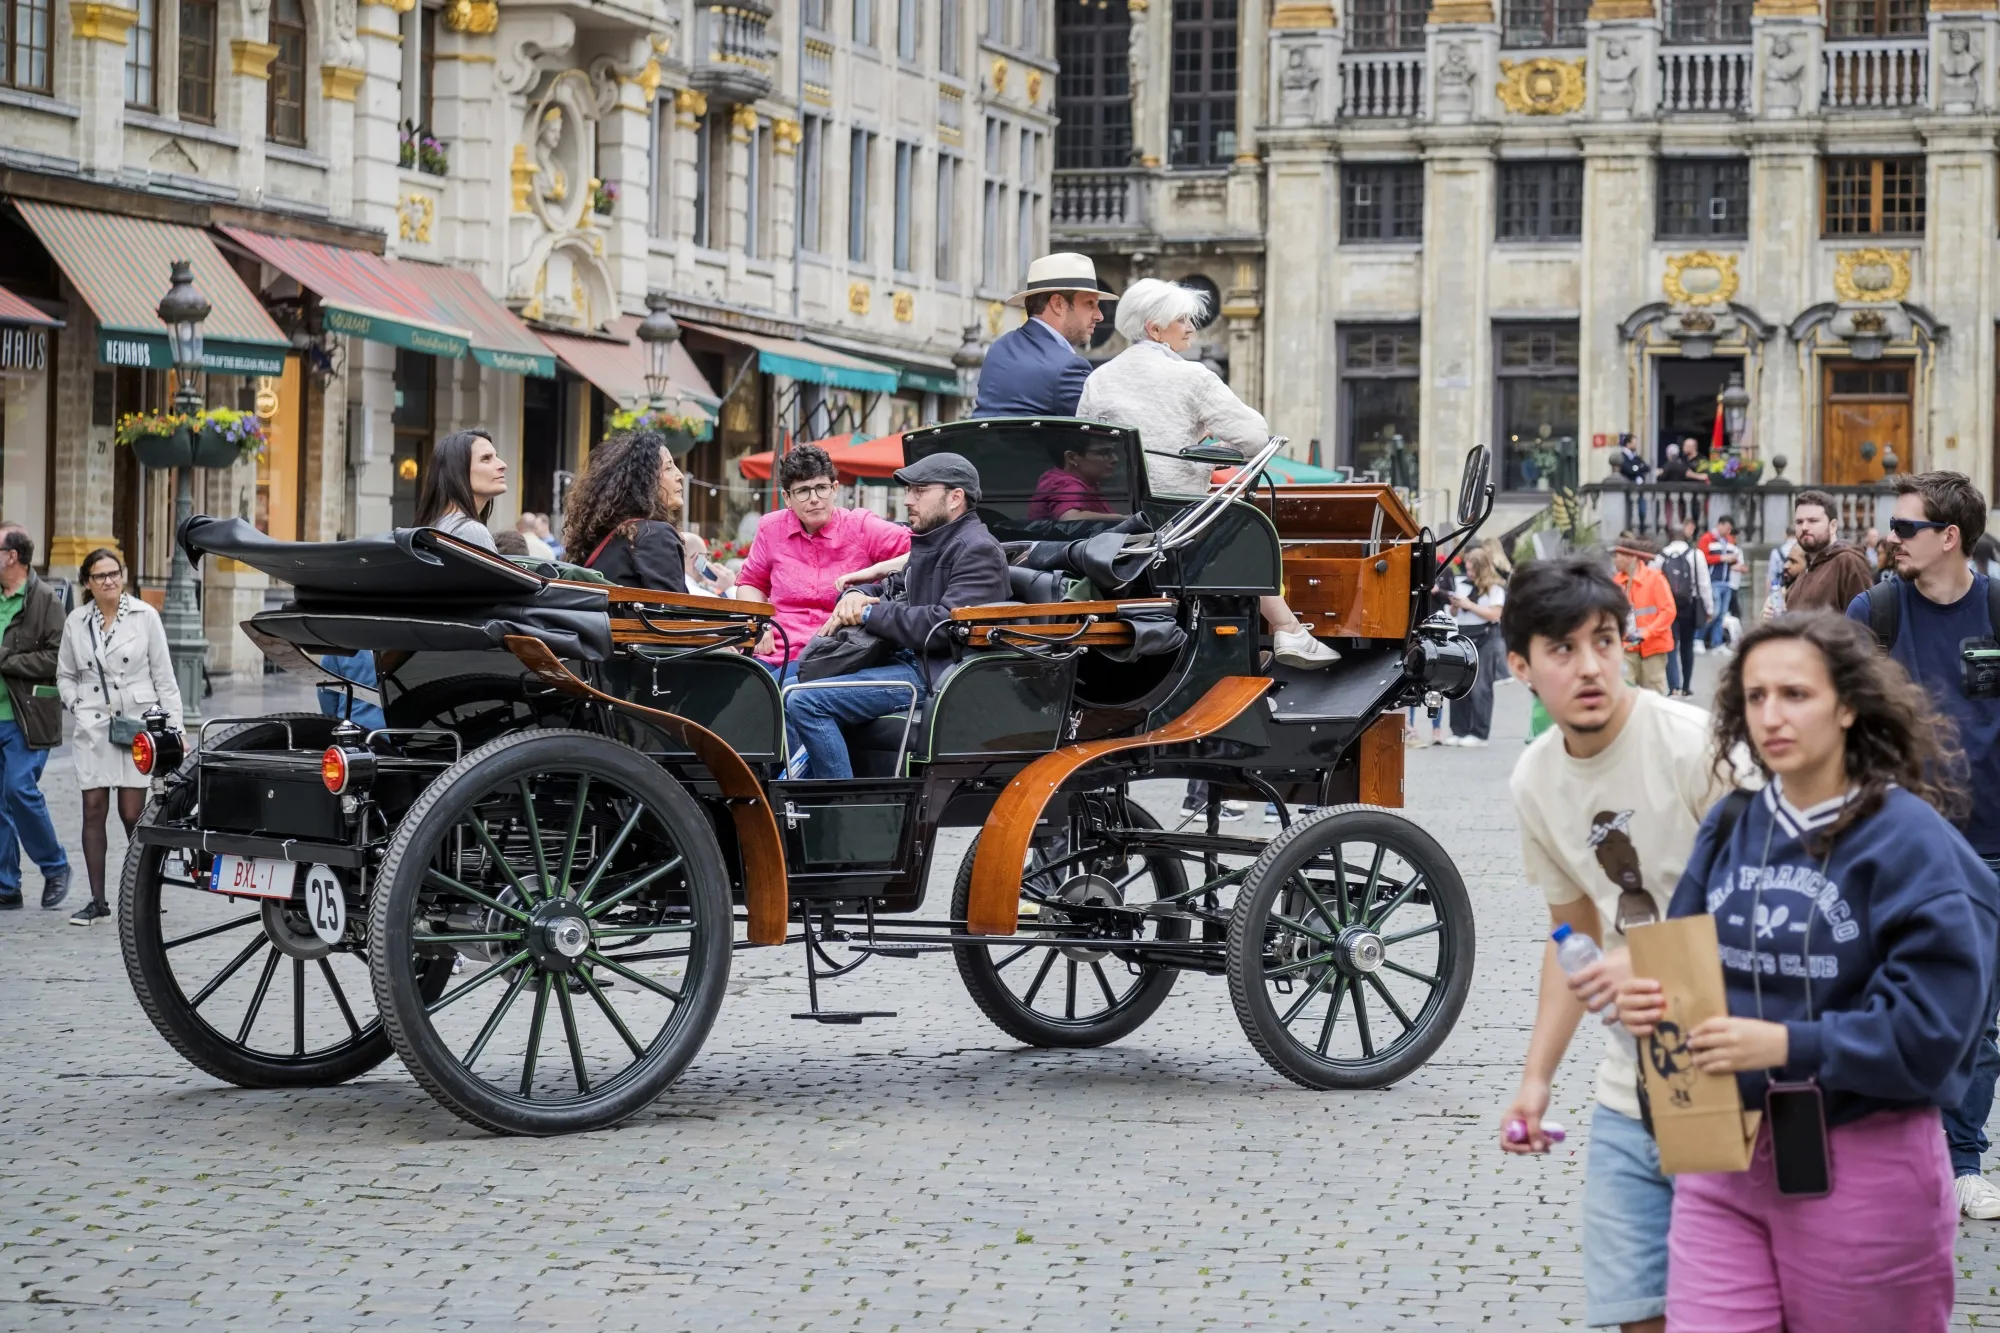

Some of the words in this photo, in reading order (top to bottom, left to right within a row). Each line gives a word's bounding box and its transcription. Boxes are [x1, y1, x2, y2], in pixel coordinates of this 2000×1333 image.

[106, 340, 151, 367] NEUHAUS
[212, 874, 218, 886] B
[233, 861, 257, 889] BXL
[311, 878, 339, 932] 25
[1718, 944, 1777, 975] PORTS
[1779, 953, 1839, 979] CLUB
